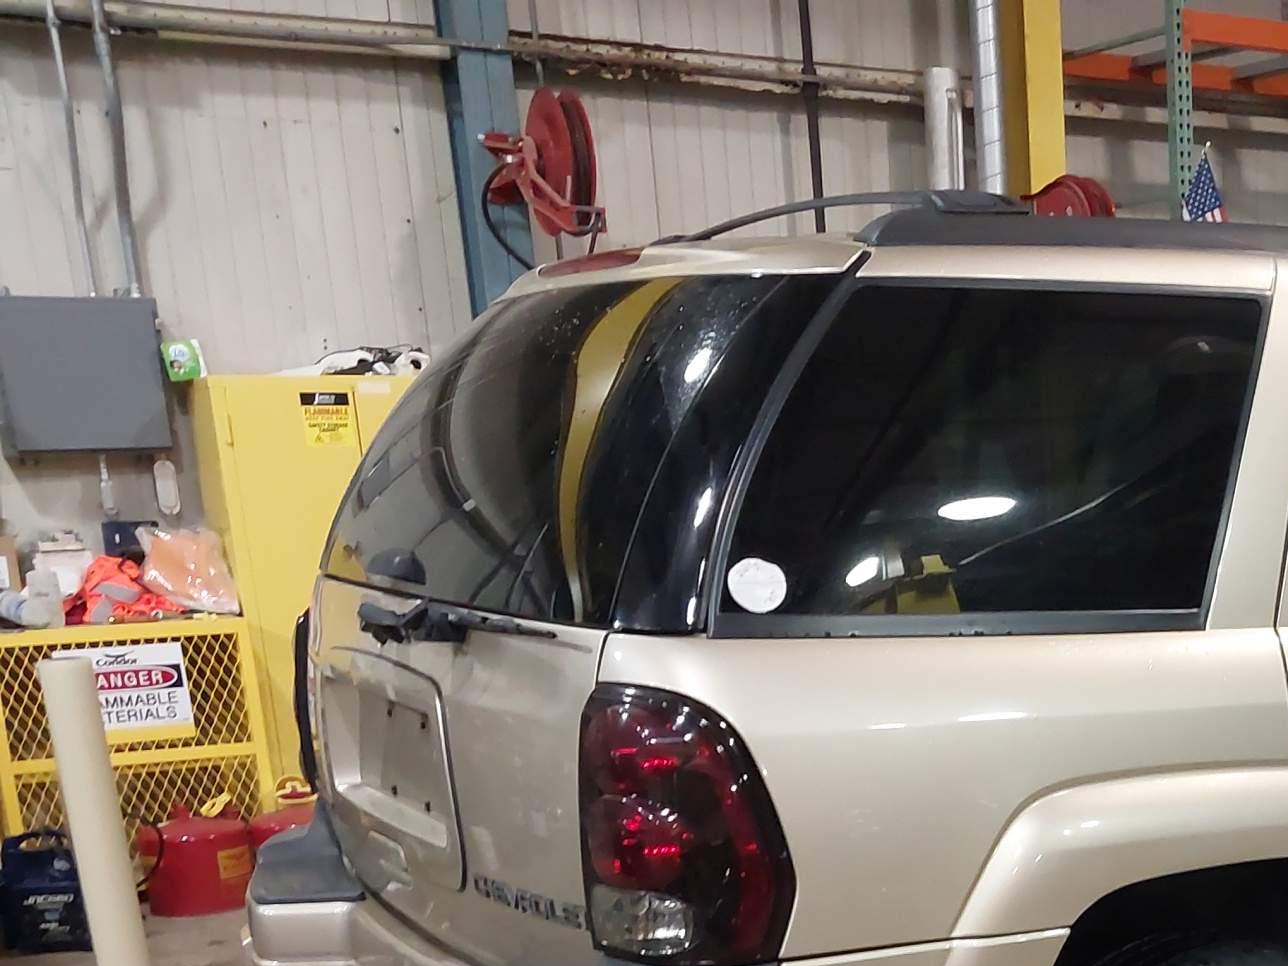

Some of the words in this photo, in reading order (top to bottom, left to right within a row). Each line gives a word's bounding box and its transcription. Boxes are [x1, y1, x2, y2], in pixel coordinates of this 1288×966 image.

[96, 671, 164, 689] ANGER
[101, 690, 180, 710] MMABLE
[104, 706, 178, 724] TERIALS
